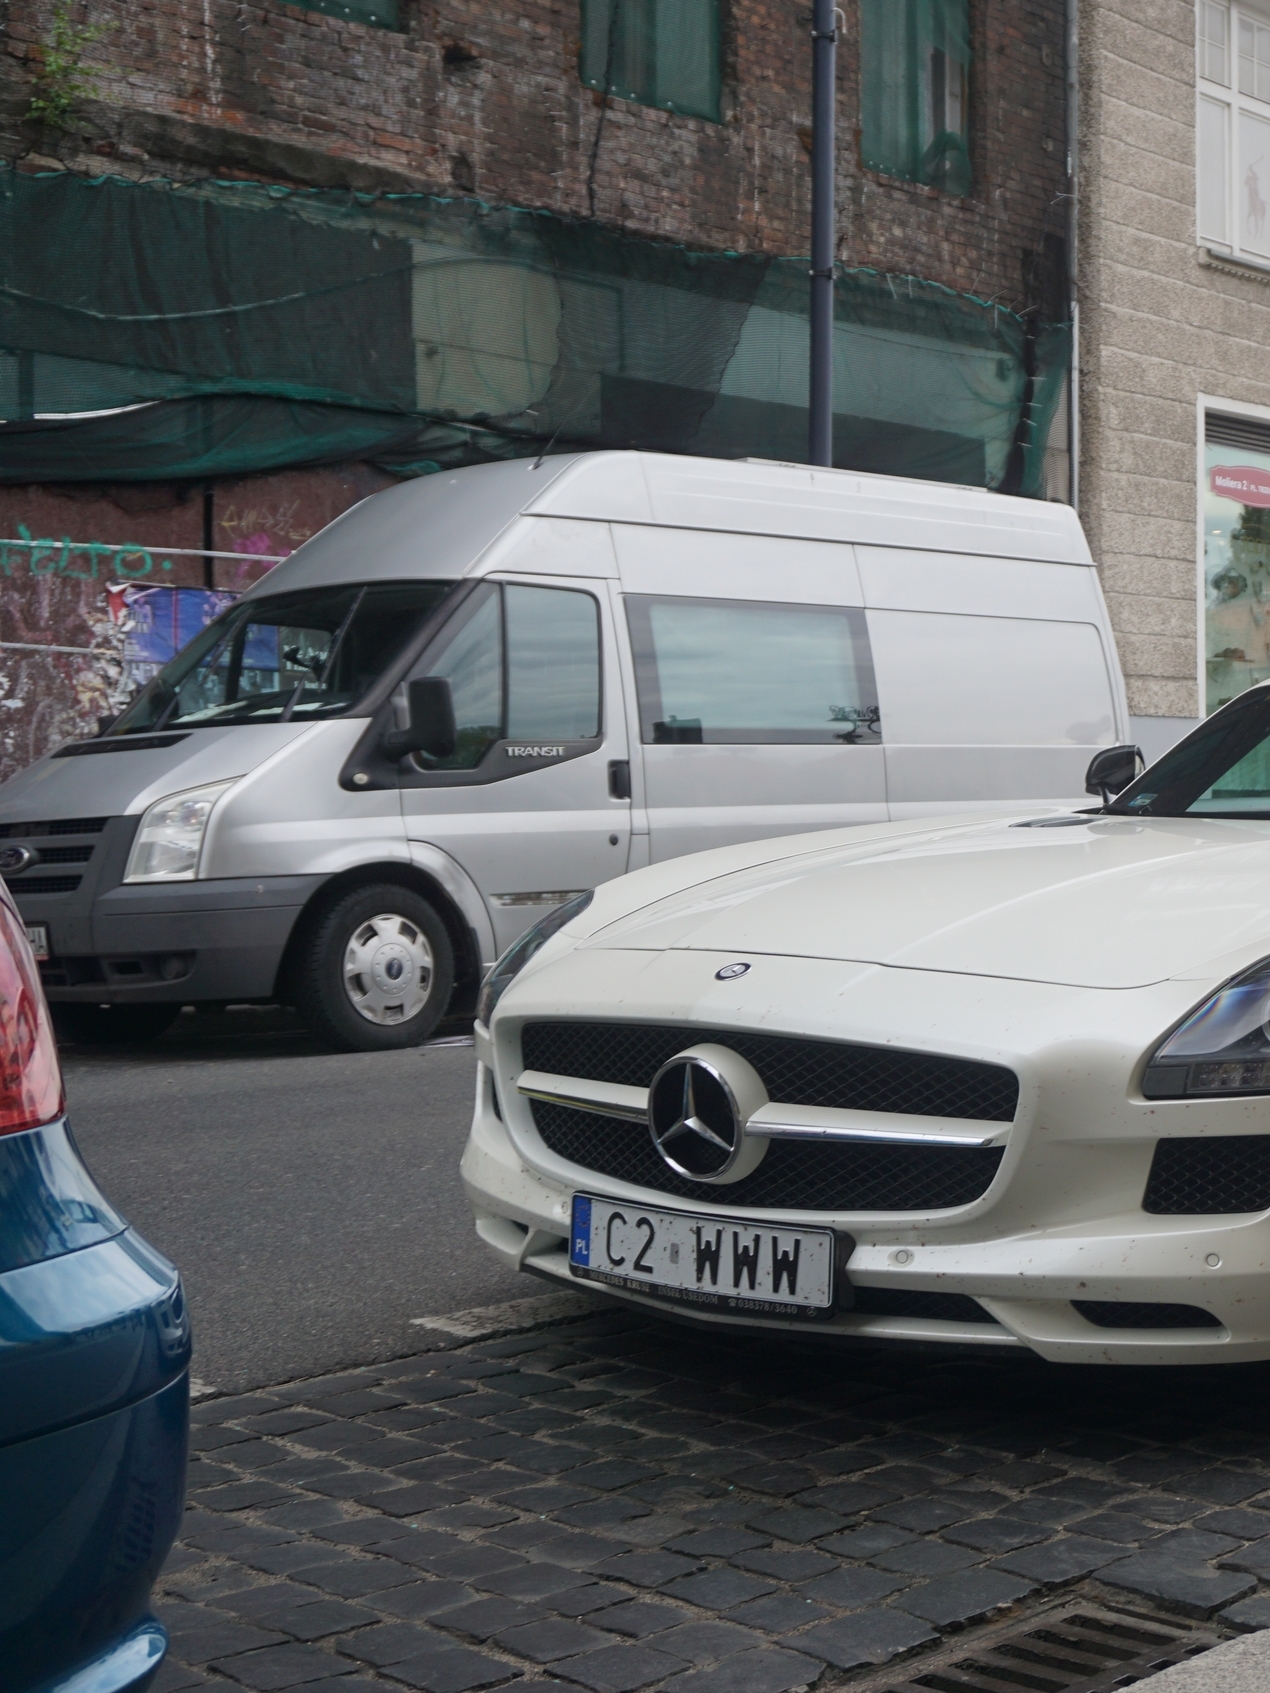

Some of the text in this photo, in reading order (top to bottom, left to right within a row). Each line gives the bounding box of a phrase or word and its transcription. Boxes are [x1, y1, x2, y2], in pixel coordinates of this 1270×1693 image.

[1215, 475, 1241, 489] Moliera
[1242, 480, 1248, 491] 2
[505, 746, 565, 757] TRANSIT
[575, 1238, 588, 1255] PL
[606, 1211, 802, 1296] C2 WWW
[589, 1270, 624, 1287] MERCEDES
[626, 1279, 651, 1292] KRUSE
[658, 1285, 681, 1299] INSEL
[682, 1290, 719, 1304] USEDOM
